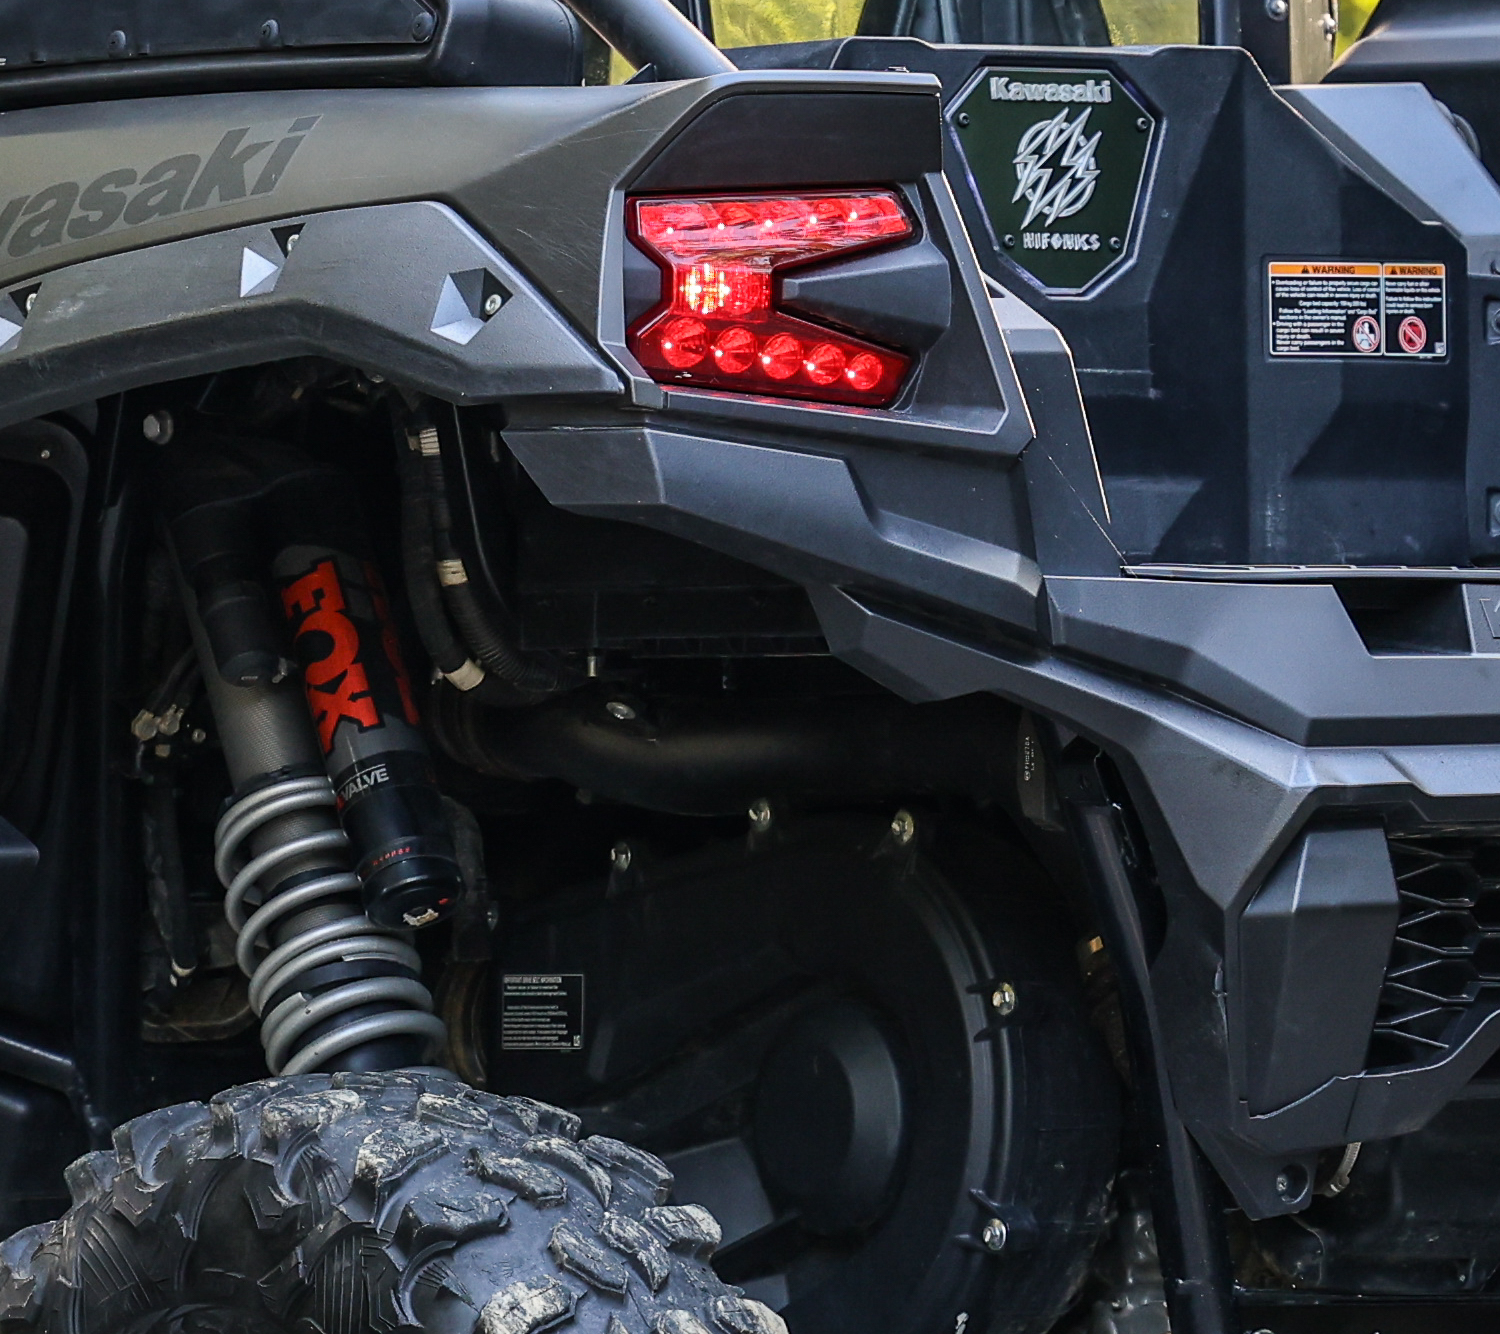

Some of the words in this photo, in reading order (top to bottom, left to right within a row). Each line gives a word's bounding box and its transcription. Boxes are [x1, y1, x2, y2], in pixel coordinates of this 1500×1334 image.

[989, 76, 1112, 103] Kawasaki
[1312, 265, 1355, 274] WARNING
[1399, 266, 1438, 275] WARNING
[281, 559, 386, 754] FOX
